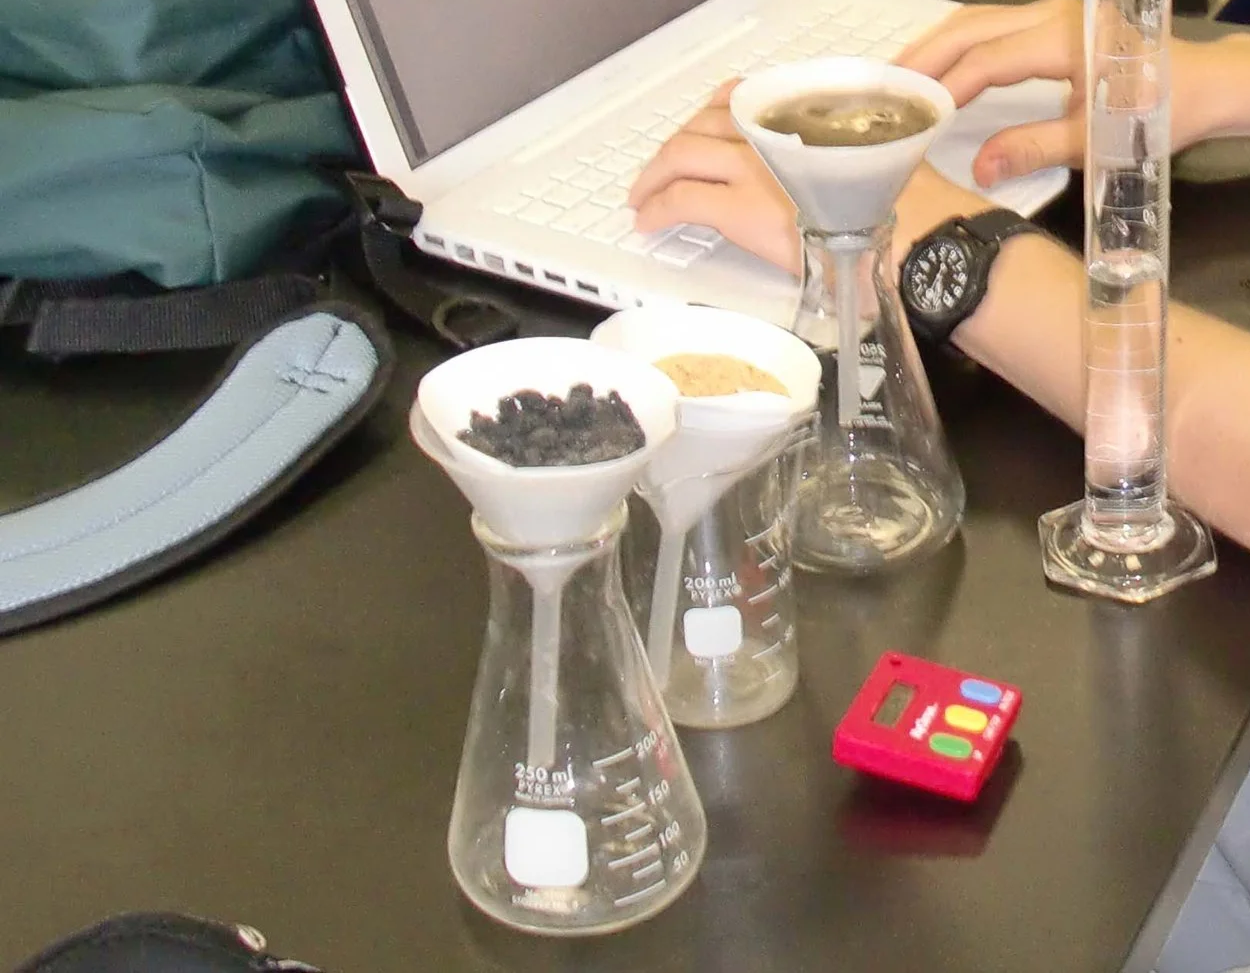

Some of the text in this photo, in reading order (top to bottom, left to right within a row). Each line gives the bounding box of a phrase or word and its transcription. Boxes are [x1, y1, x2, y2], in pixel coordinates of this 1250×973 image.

[684, 572, 736, 590] 200 ml
[635, 730, 657, 760] 200
[513, 762, 574, 784] 250 ml
[648, 779, 670, 806] 150
[659, 820, 680, 847] 100
[673, 850, 690, 872] 50
